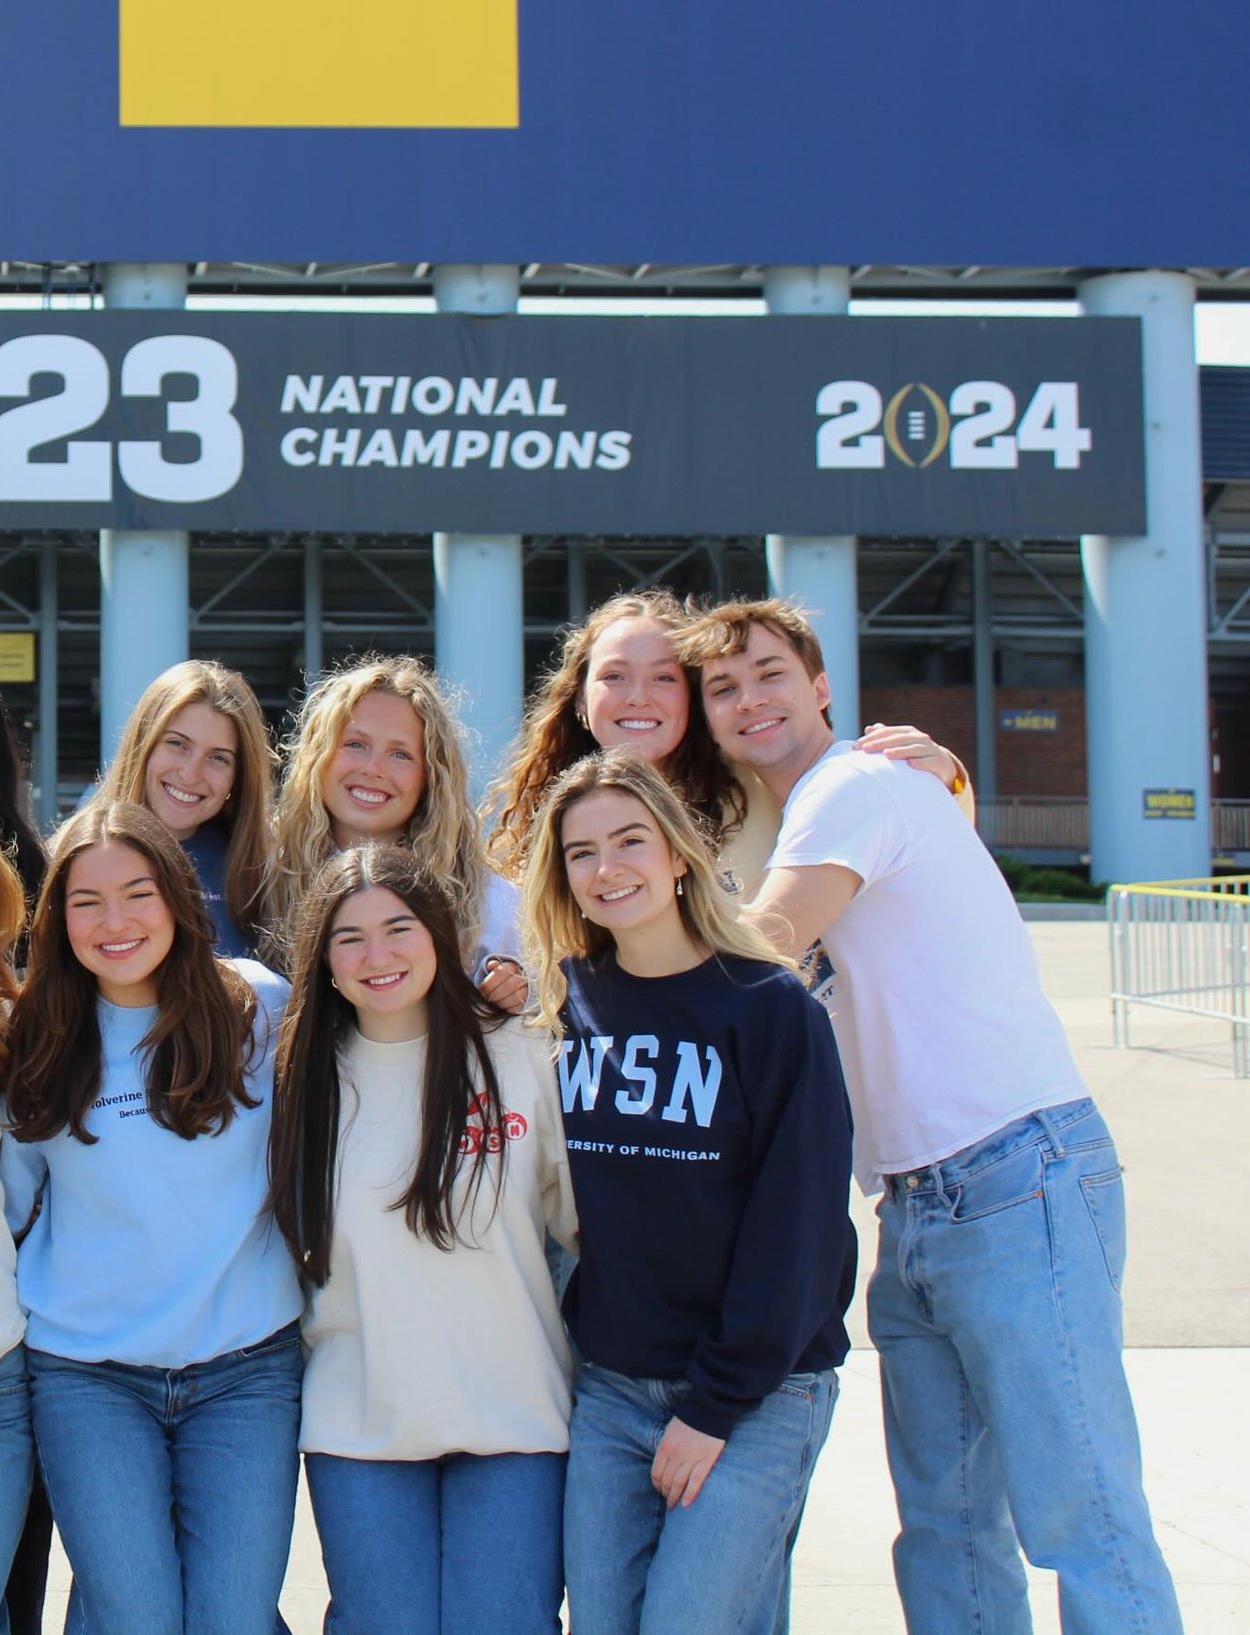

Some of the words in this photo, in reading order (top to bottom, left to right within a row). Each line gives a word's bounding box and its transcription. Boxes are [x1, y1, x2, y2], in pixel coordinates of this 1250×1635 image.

[280, 374, 568, 417] NATIONAL
[280, 427, 633, 470] CHAMPIONS
[1015, 715, 1056, 730] MEN
[557, 1034, 723, 1129] WSN
[119, 1107, 150, 1118] Becau
[566, 1139, 615, 1154] ERSITY
[619, 1145, 640, 1155] OF
[644, 1147, 721, 1161] MICHIGAN
